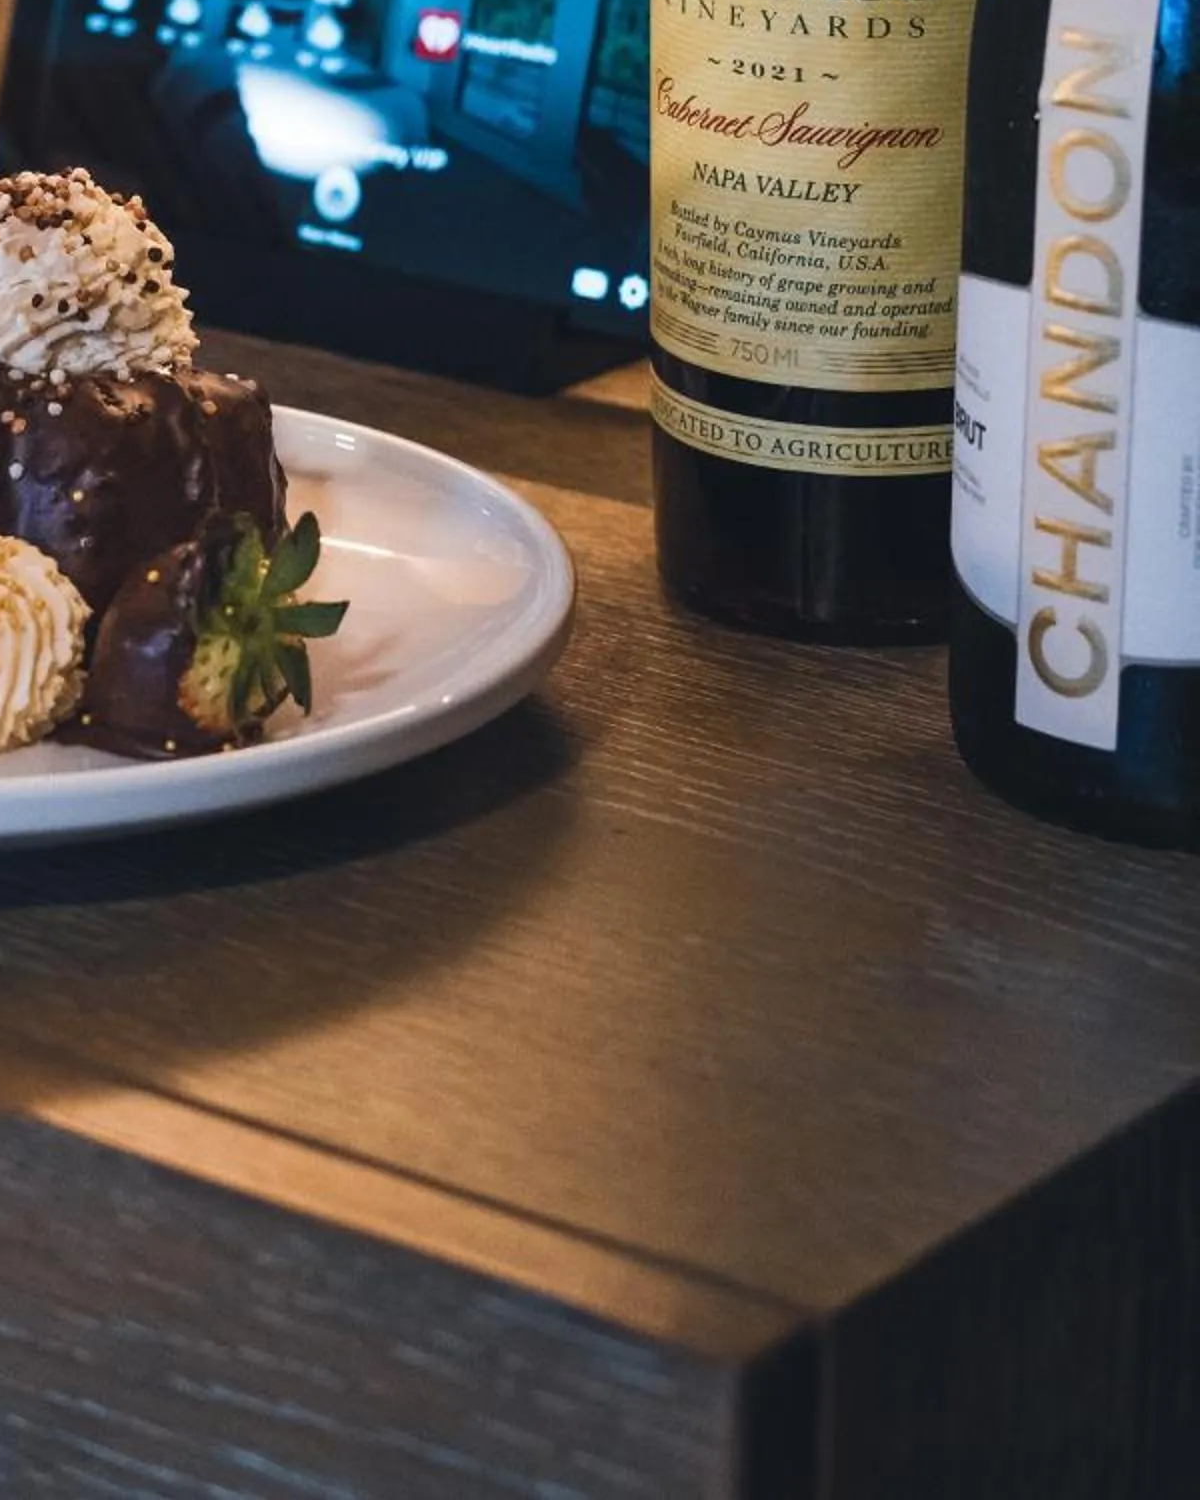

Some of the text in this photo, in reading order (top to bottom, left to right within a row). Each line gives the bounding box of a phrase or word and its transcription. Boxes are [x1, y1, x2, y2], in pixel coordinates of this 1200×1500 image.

[732, 59, 805, 83] 2021
[655, 69, 945, 169] Cabernet Sauvignon
[692, 161, 863, 205] NAPA VALLEY
[670, 199, 902, 252] Bottled by Caymus Vineyards
[675, 222, 731, 257] Fairfield,
[737, 241, 830, 272] California,
[684, 250, 706, 276] long
[709, 260, 754, 286] history
[759, 272, 776, 290] of
[777, 279, 824, 297] grape
[827, 279, 898, 298] growing
[902, 278, 936, 295] and
[723, 306, 770, 332] family
[773, 320, 815, 336] since
[819, 324, 849, 337] our
[785, 299, 839, 316] owned
[843, 301, 877, 317] and
[881, 298, 953, 320] operated
[730, 338, 769, 365] 750
[1028, 26, 1137, 698] CHANDON
[729, 429, 763, 451] TO
